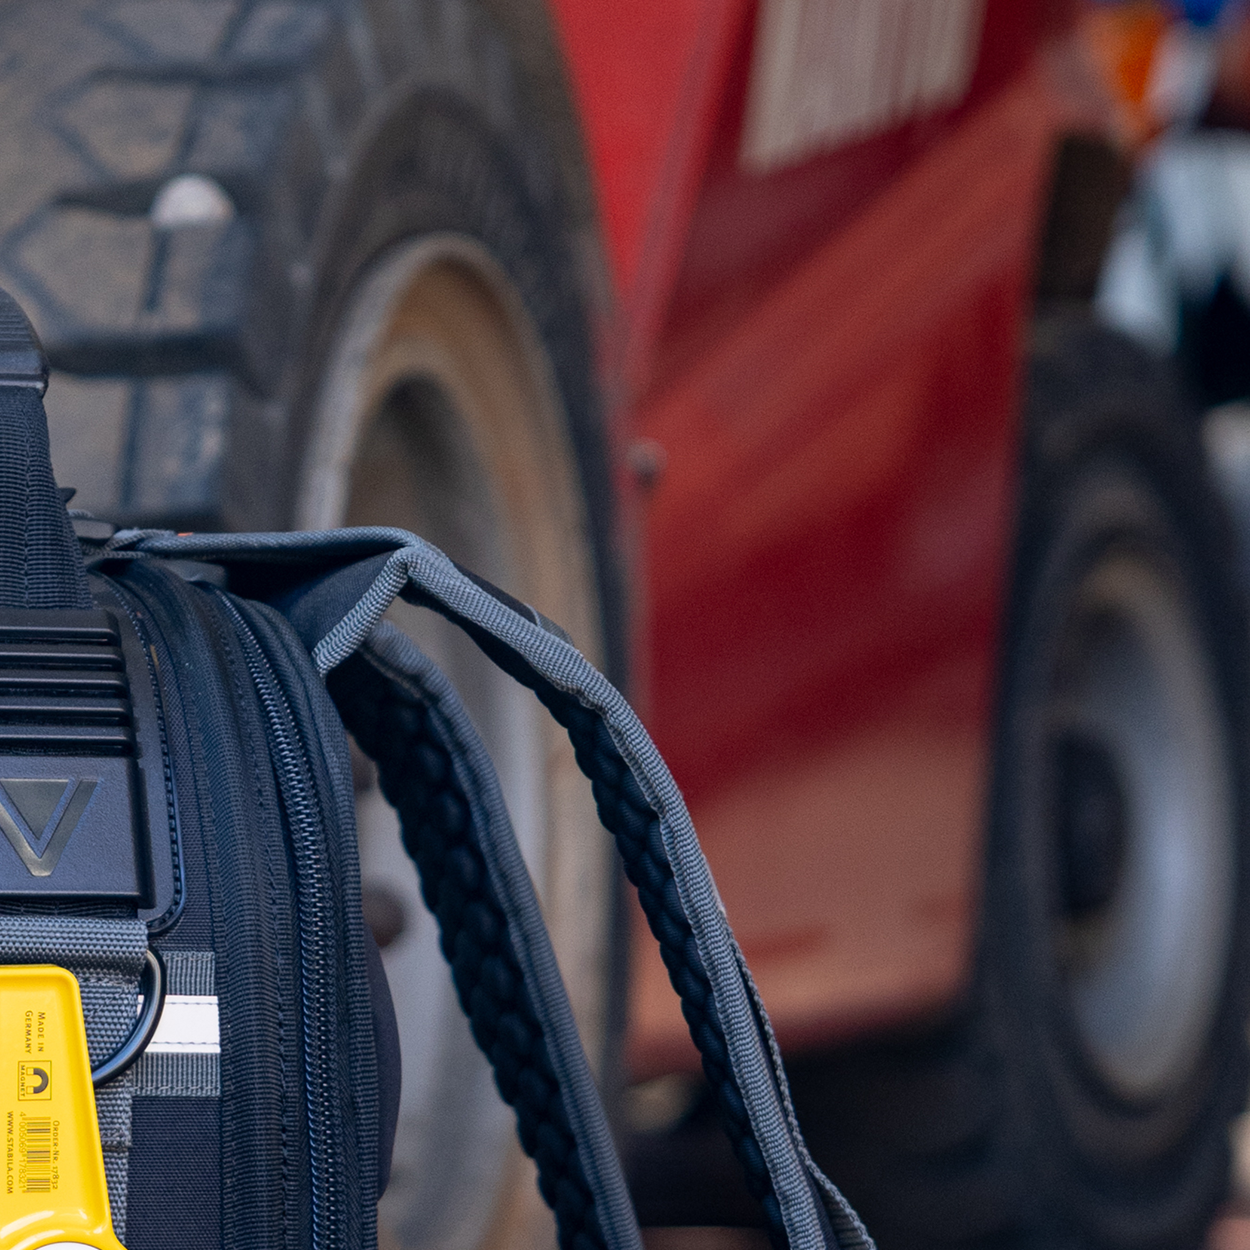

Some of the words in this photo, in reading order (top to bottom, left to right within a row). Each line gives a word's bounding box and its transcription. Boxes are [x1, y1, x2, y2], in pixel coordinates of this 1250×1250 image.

[25, 1010, 34, 1054] GERMANY
[6, 1110, 14, 1194] WWW.STABILA.COM
[51, 1166, 60, 1190] 17832
